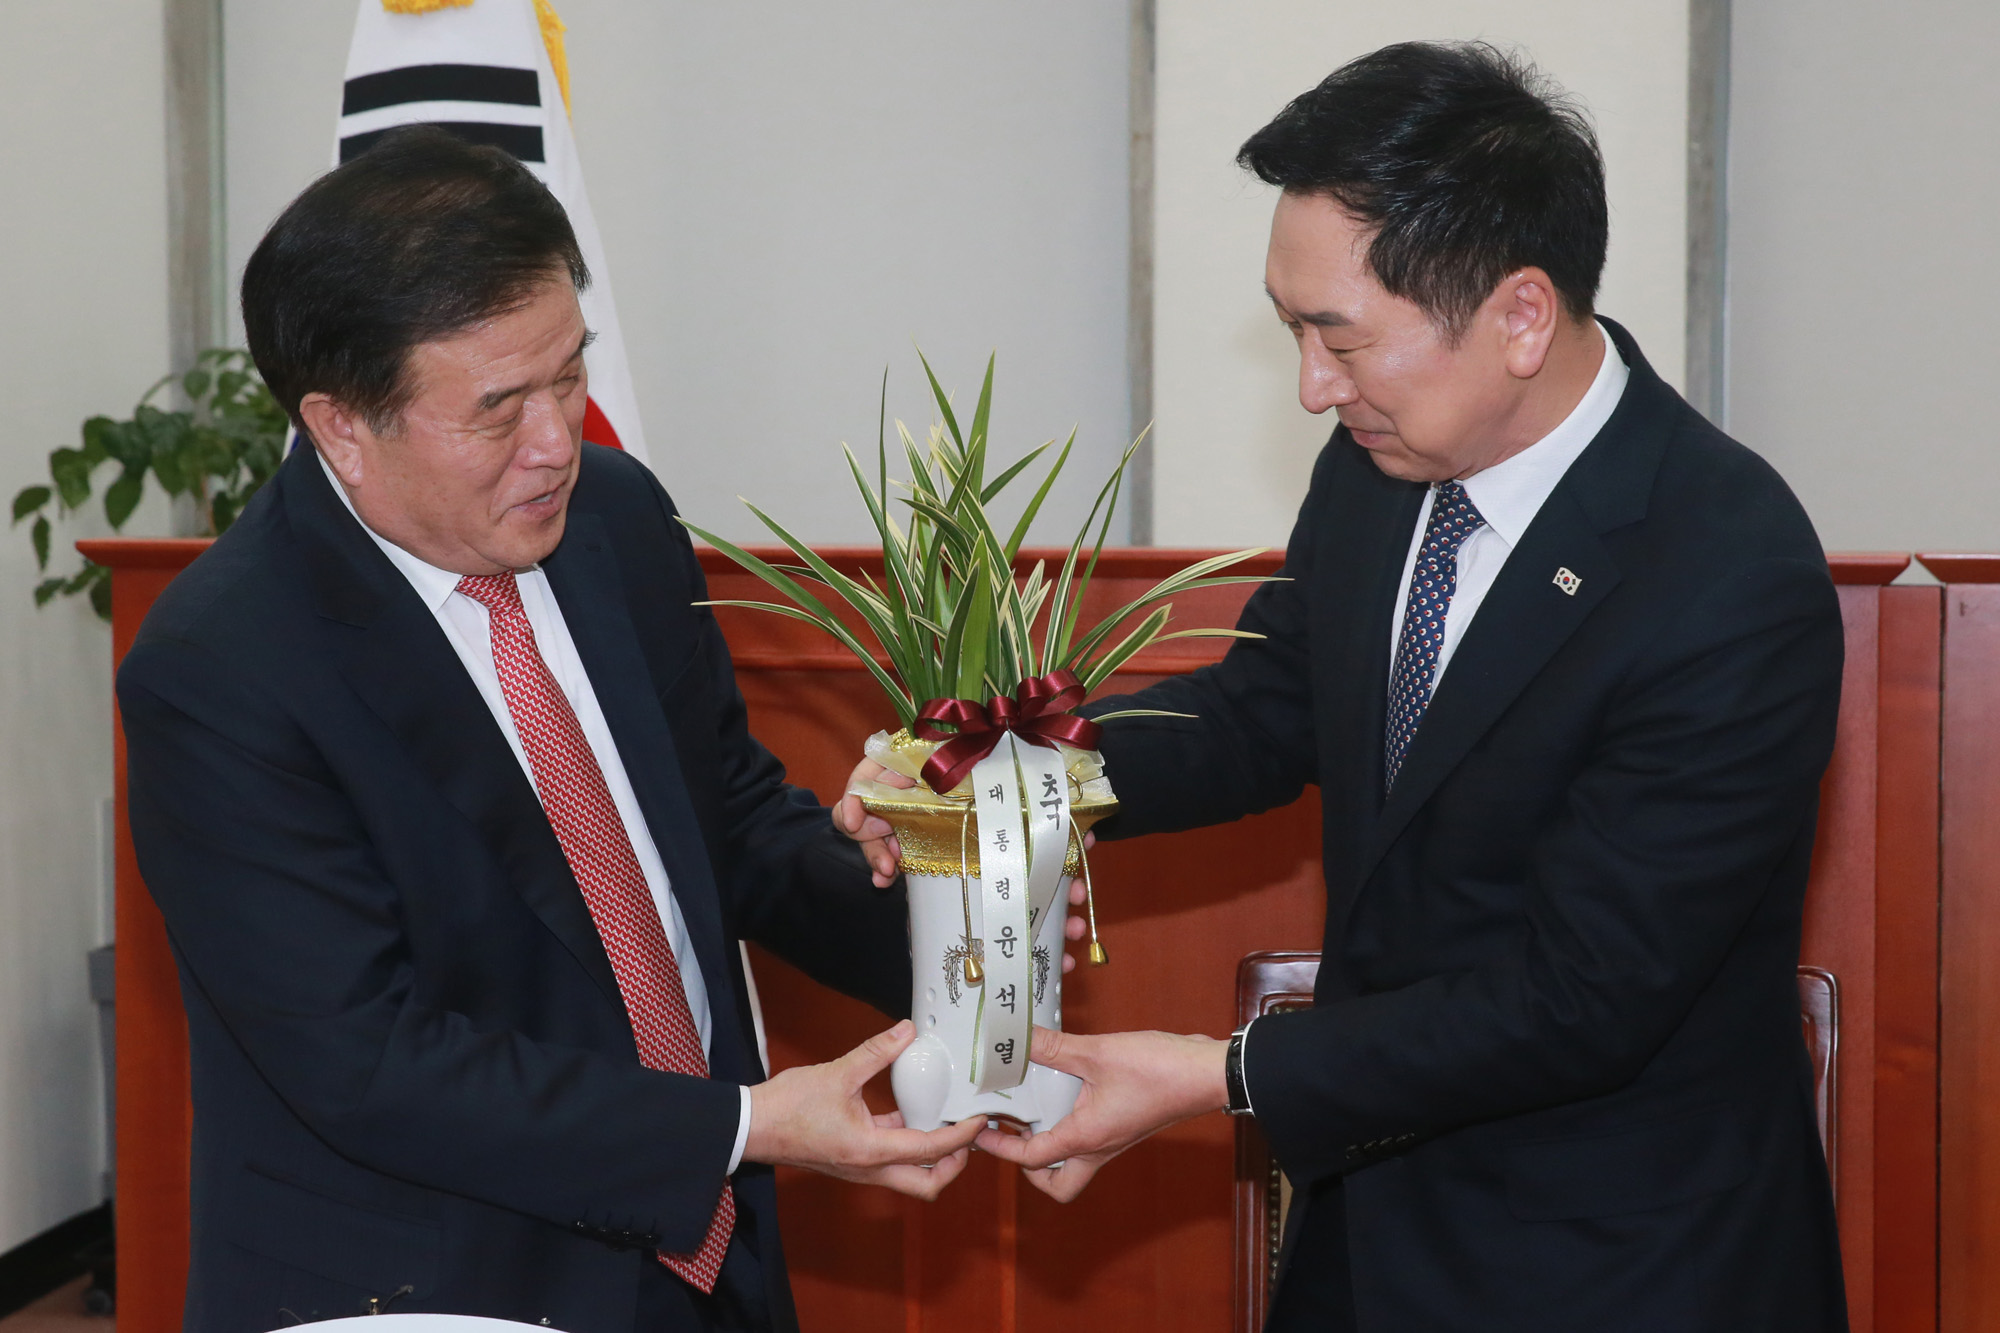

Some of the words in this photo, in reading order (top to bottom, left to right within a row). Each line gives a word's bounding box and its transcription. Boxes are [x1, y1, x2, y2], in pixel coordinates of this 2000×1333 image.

[988, 783, 1010, 901] 대통령
[1039, 773, 1063, 831] 축
[993, 925, 1018, 1065] 윤석열
